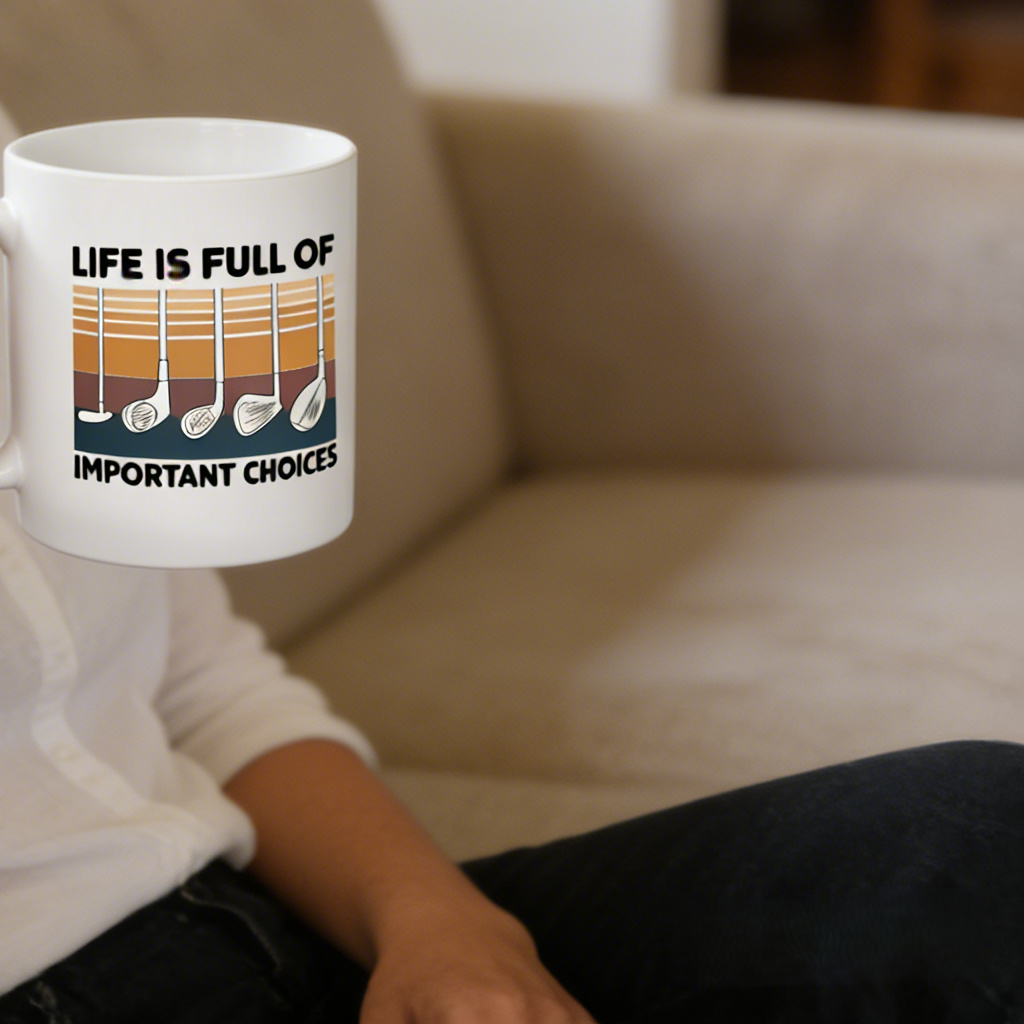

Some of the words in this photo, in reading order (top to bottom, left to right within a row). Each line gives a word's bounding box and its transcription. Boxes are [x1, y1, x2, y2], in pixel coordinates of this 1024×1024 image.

[72, 245, 144, 280] LIFE
[155, 247, 191, 281] IS
[201, 243, 287, 280] FULL
[293, 233, 336, 270] OF
[74, 454, 237, 488] IMPORTANT
[243, 442, 338, 485] CHOICES
